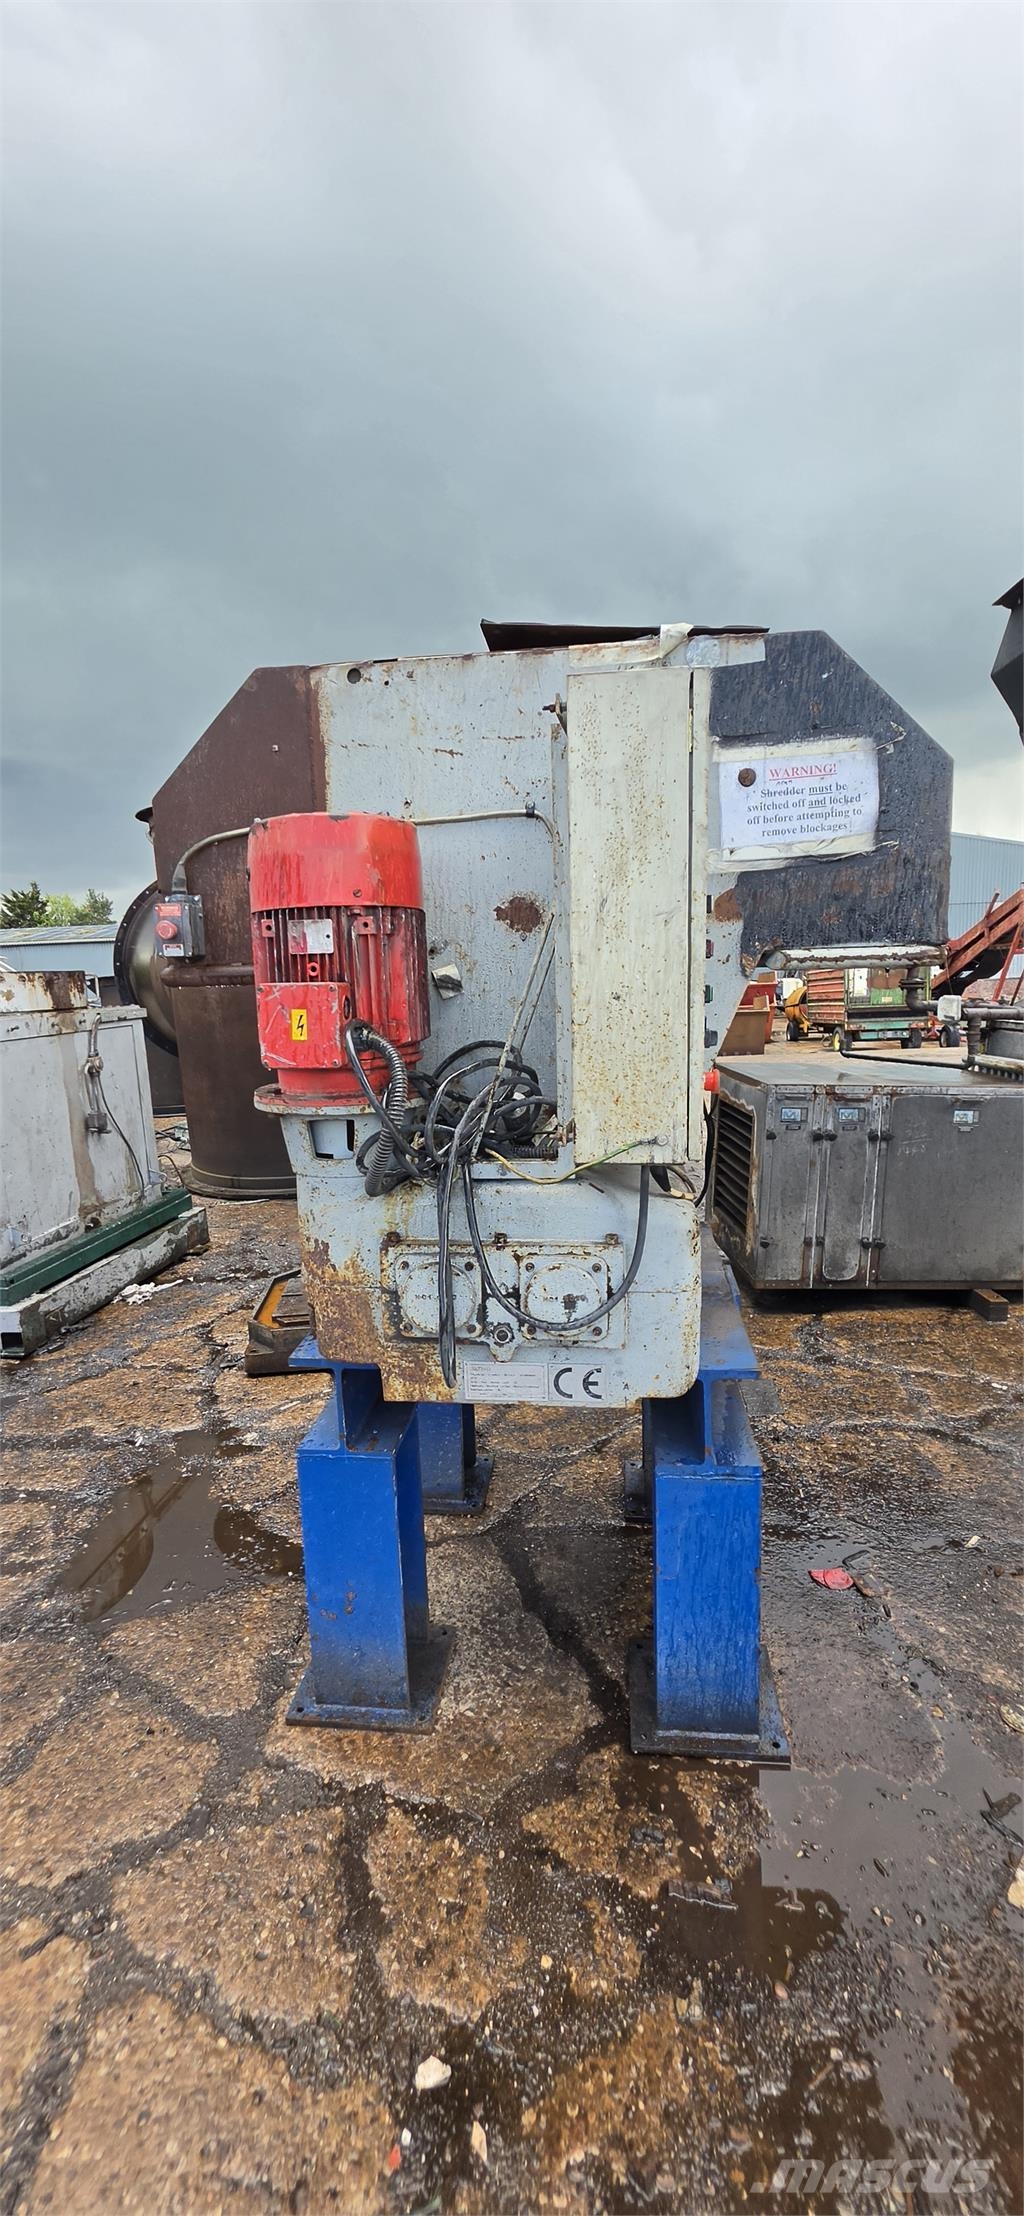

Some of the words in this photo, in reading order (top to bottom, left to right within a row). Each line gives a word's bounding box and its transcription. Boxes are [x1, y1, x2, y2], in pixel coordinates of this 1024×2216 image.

[769, 763, 837, 779] WARNING!
[760, 786, 805, 798] Shredder
[808, 784, 833, 796] must
[835, 782, 848, 792] be
[747, 799, 790, 813] switched
[792, 799, 806, 808] off
[808, 797, 827, 809] and
[829, 794, 861, 805] locked
[747, 815, 761, 825] off
[763, 813, 794, 824] before
[796, 808, 850, 822] attempting
[852, 808, 862, 816] to
[762, 827, 797, 837] remove
[800, 822, 848, 835] blockages
[553, 1367, 602, 1400] CE
